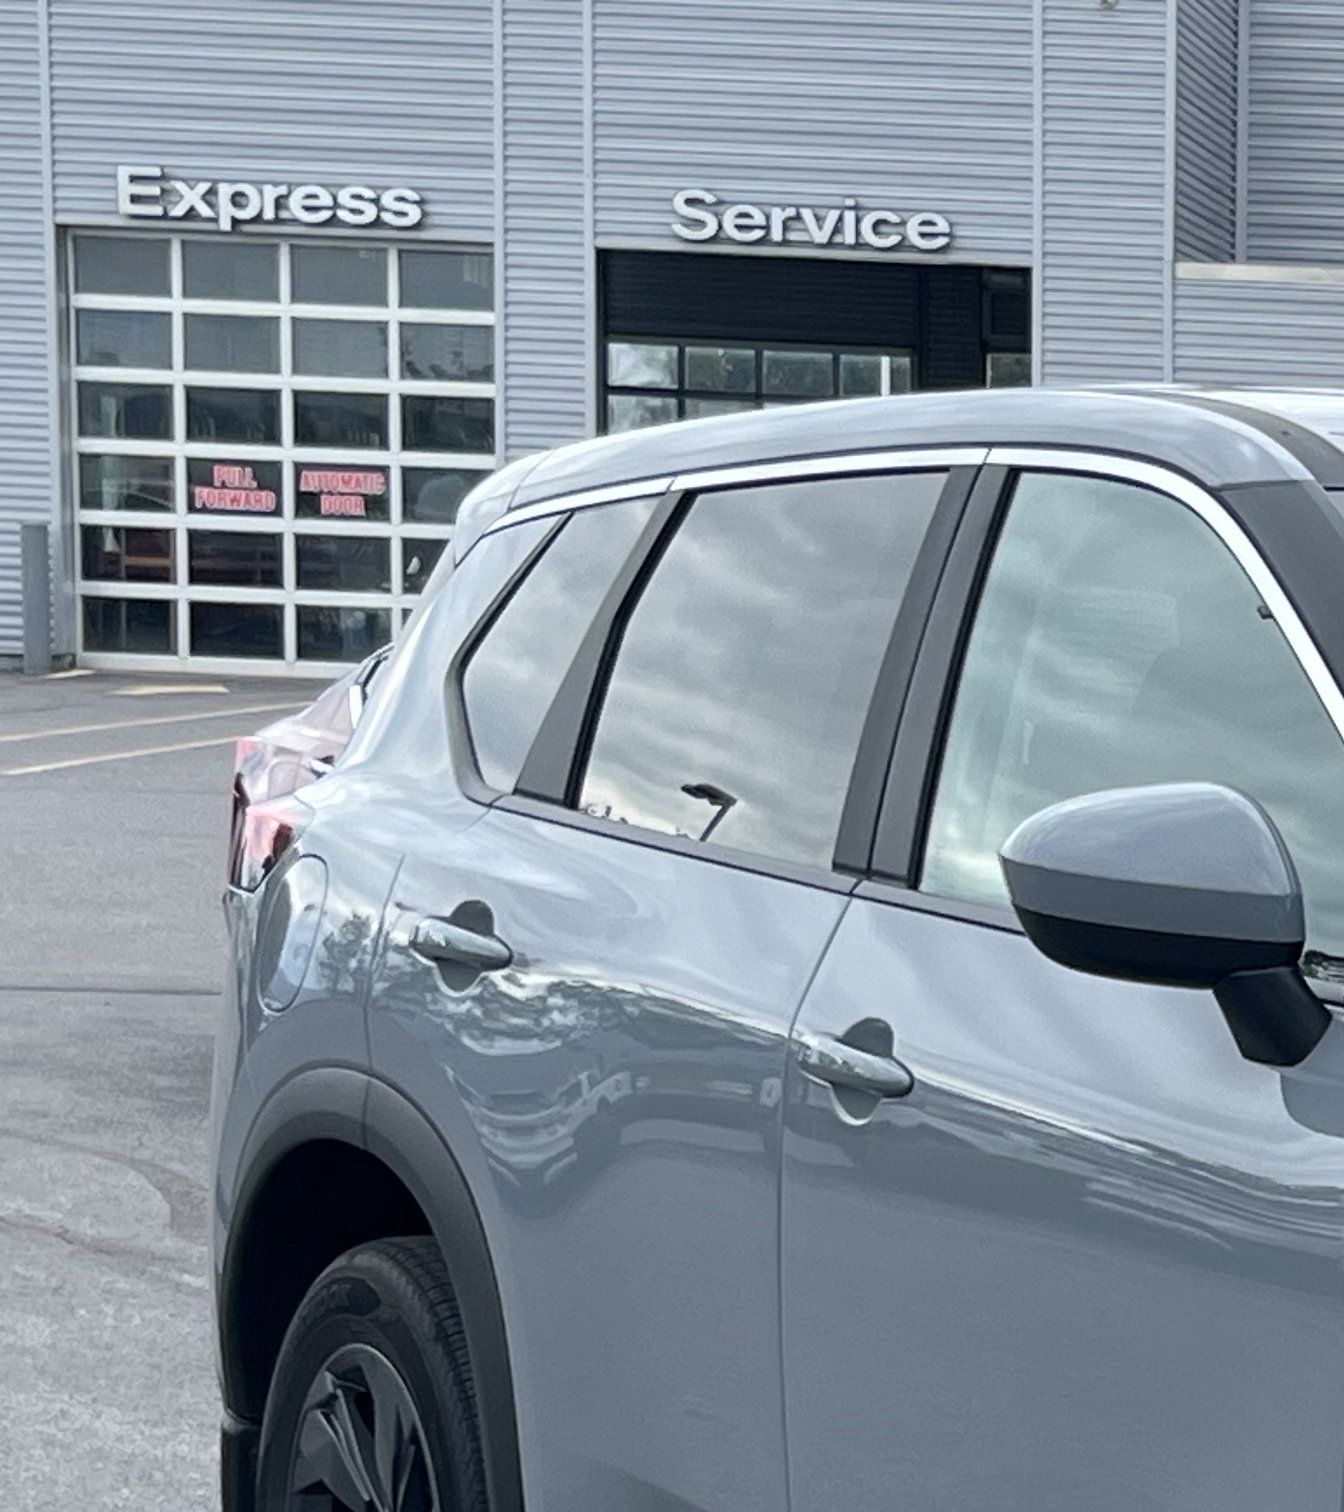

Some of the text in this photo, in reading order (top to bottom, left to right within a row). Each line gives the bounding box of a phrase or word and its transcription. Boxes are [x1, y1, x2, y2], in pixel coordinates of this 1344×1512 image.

[117, 165, 424, 231] Express
[671, 189, 952, 250] Service
[213, 465, 258, 488] PULL
[299, 470, 386, 495] AUTOMATIC
[195, 487, 276, 512] FORWARD
[320, 495, 367, 516] DOOR
